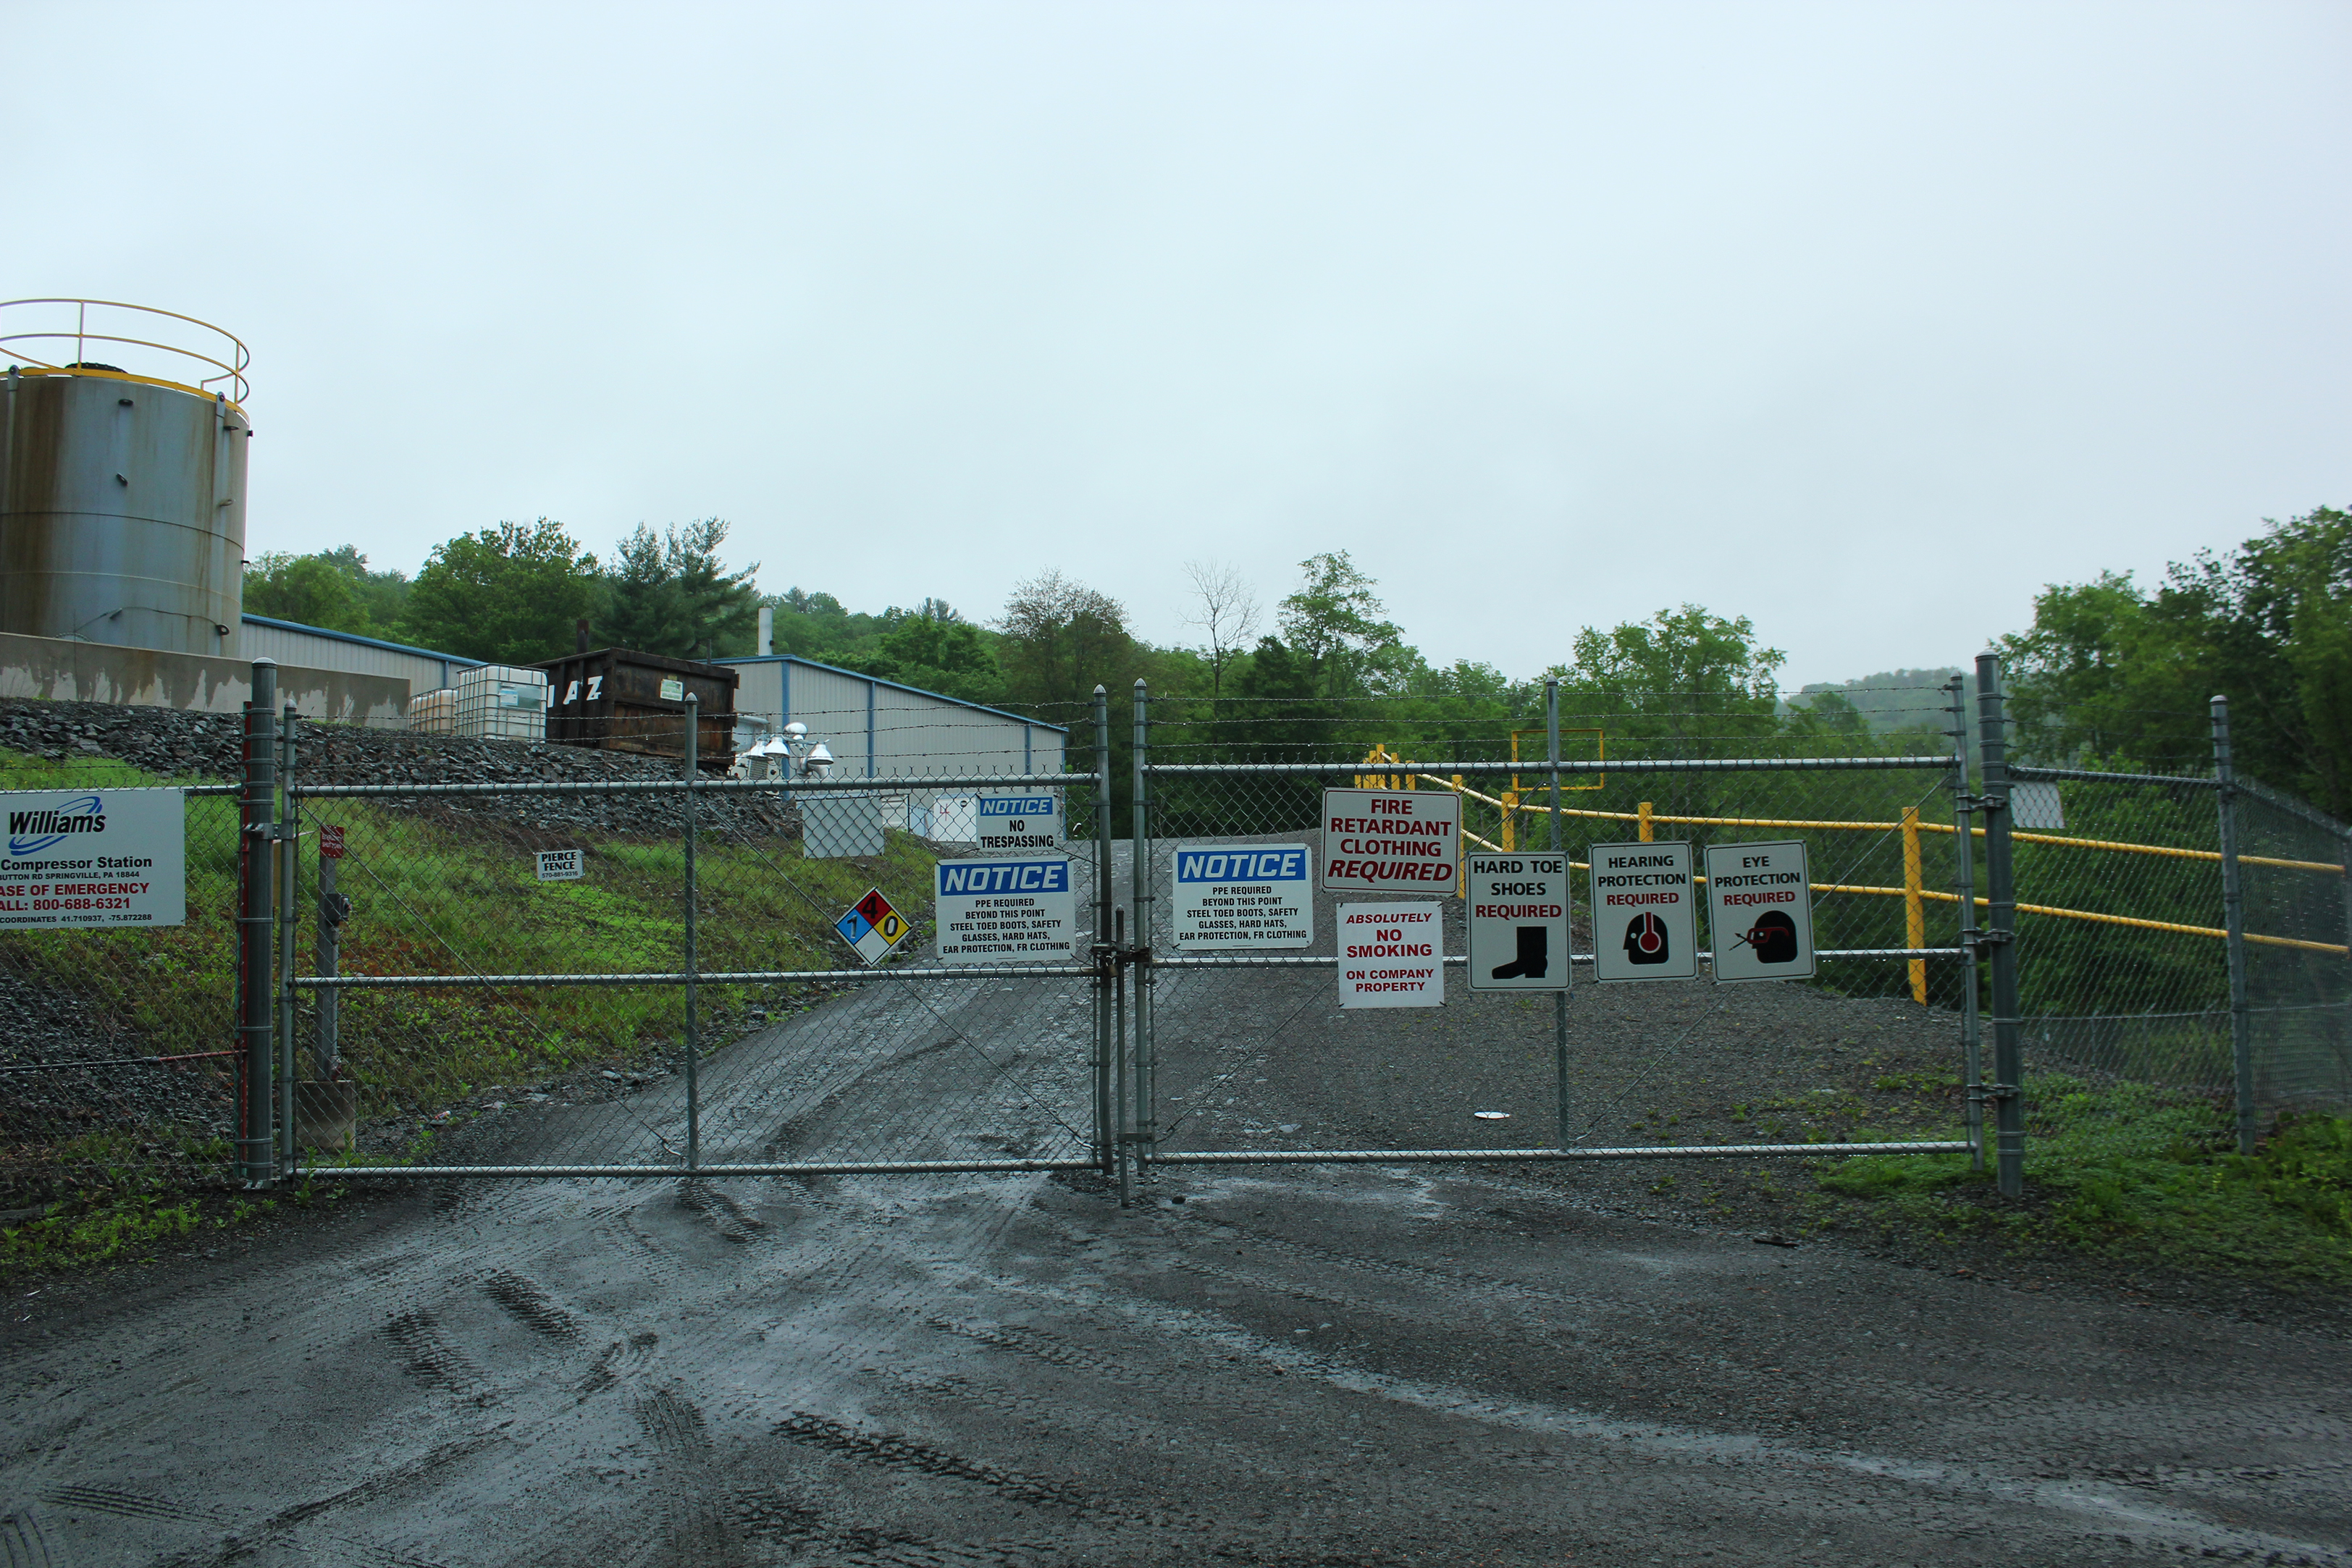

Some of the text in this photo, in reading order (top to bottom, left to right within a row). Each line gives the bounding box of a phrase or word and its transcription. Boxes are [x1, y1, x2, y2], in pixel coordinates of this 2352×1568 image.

[983, 799, 1050, 814] NOTICE
[1371, 799, 1412, 814] FIRE
[9, 810, 106, 835] Williams
[1009, 819, 1025, 832] NO
[1331, 817, 1452, 836] RETARDANT
[980, 835, 1054, 848] TRESPASSING
[1340, 838, 1441, 857] CLOTHING
[542, 852, 576, 861] PIERCE
[1608, 855, 1674, 869] HEARING
[1742, 856, 1770, 868] EYE
[1, 856, 152, 872] Compressor Station
[545, 861, 575, 871] FENCE
[1182, 853, 1301, 878] NOTICE
[1474, 860, 1563, 874] HARD TOE
[1327, 859, 1453, 883] REQUIRED
[944, 865, 1063, 891] NOTICE
[1598, 873, 1686, 888] PROTECTION
[1715, 872, 1800, 888] PROTECTION
[30, 885, 50, 895] OF
[55, 882, 149, 895] EMERGENCY
[1231, 886, 1272, 895] REQUIRED
[1491, 882, 1546, 895] SHOES
[33, 898, 130, 910] 800-688-6321
[994, 898, 1034, 907] REQUIRED
[1606, 893, 1679, 908] REQUIRED
[1723, 891, 1796, 907] REQUIRED
[862, 896, 878, 919] 4
[1187, 909, 1211, 918] STEEL
[1237, 909, 1266, 918] BOOTS,
[1475, 905, 1562, 921] REQUIRED
[965, 911, 997, 919] BEYOND
[1346, 913, 1432, 924] ABSOLUTELY
[847, 915, 857, 938] 1
[883, 915, 899, 937] 0
[950, 919, 1061, 931] STEEL TOED BOOTS, SAFETY
[1198, 919, 1287, 930] GLASSES, HARD HATS,
[962, 933, 1000, 942] GLASSES,
[1027, 932, 1050, 940] HATS,
[1198, 931, 1251, 940] PROTECTION,
[1267, 930, 1306, 939] CLOTHING
[1377, 929, 1402, 942] NO
[962, 944, 1015, 953] PROTECTION,
[1030, 942, 1070, 951] CLOTHING
[1347, 943, 1432, 958] SMOKING
[1346, 969, 1434, 979] ON COMPANY
[1356, 982, 1425, 992] PROPERTY
